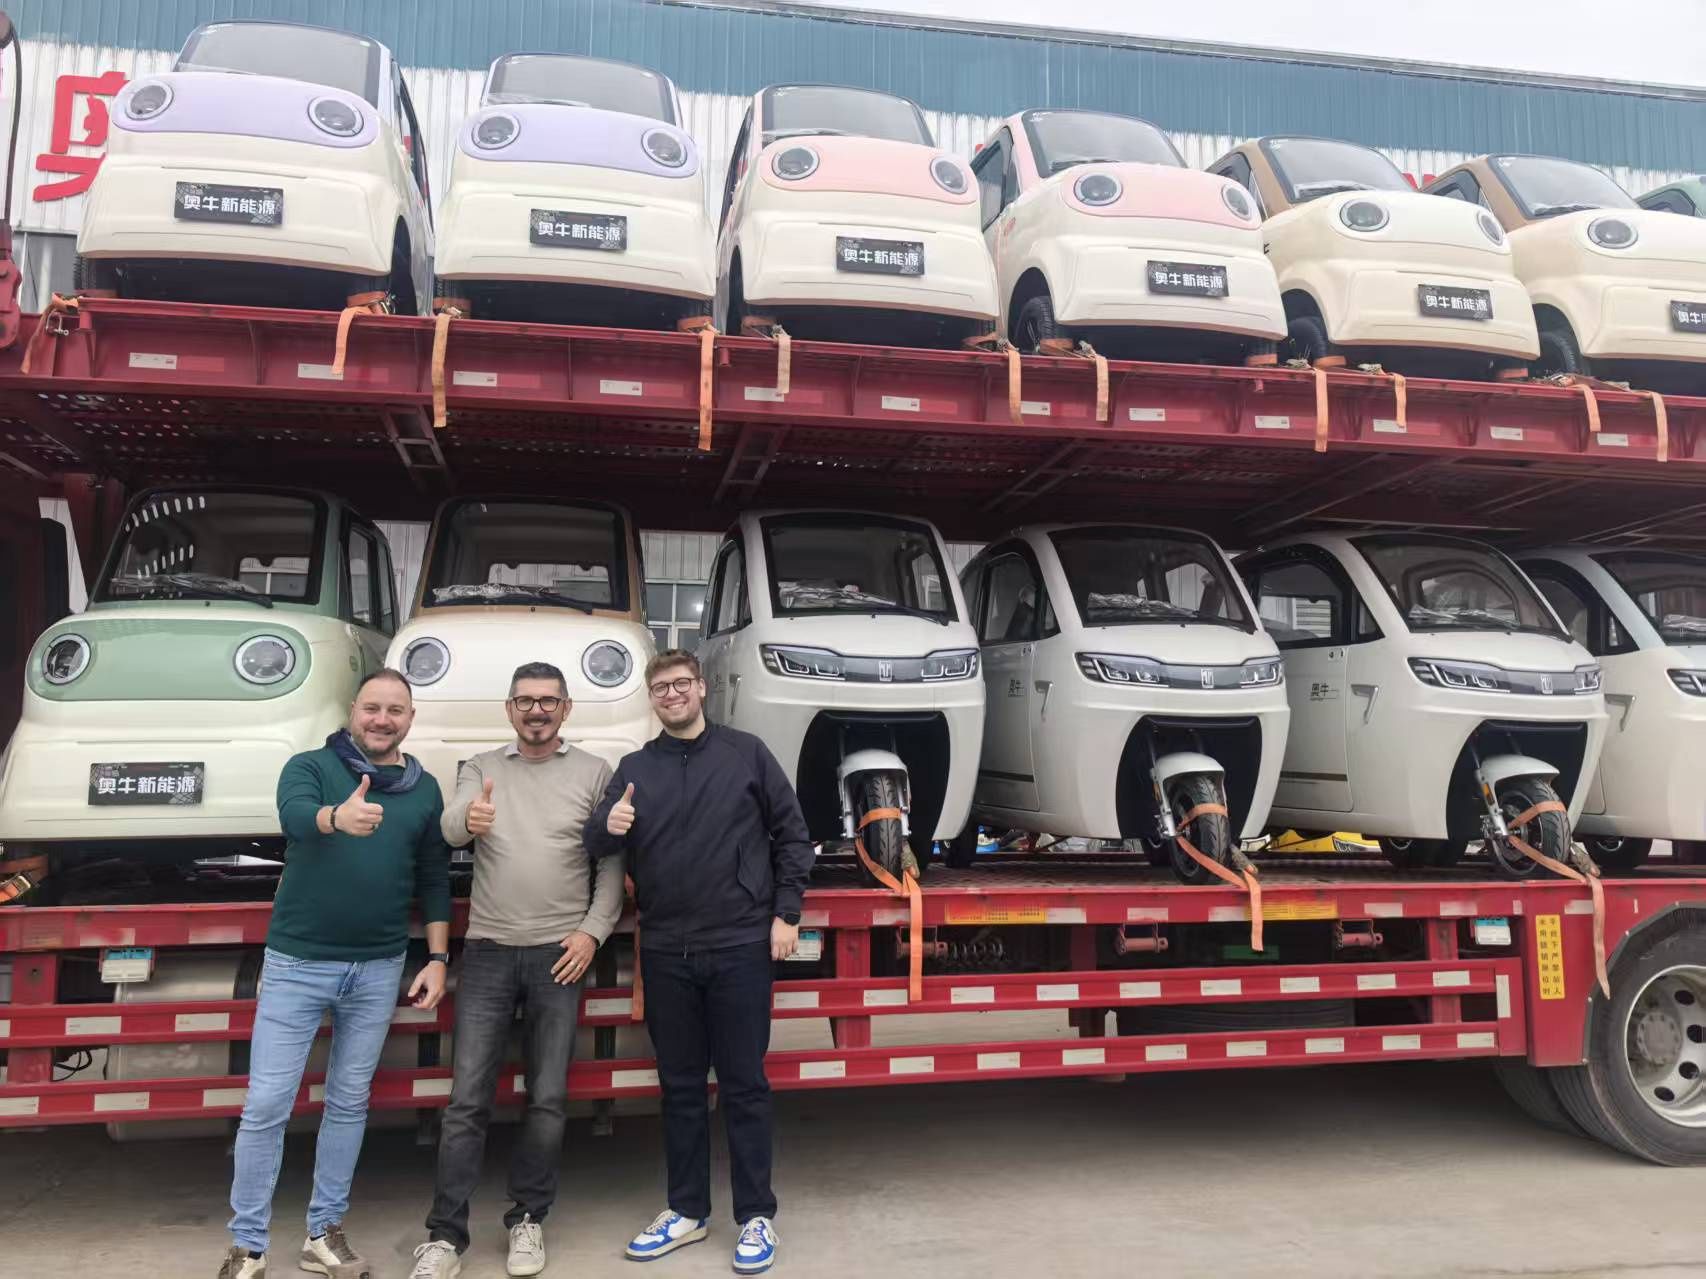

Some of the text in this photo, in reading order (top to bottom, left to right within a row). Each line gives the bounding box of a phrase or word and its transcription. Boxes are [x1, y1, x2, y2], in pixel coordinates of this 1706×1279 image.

[183, 194, 275, 215] 奥牛新能源
[538, 221, 621, 241] 奥牛新能源
[843, 248, 919, 266] 奥牛新能源
[1155, 271, 1223, 289] 奥牛新能源
[1425, 294, 1488, 312] 奥牛新能源
[98, 776, 196, 795] 奥牛新能源
